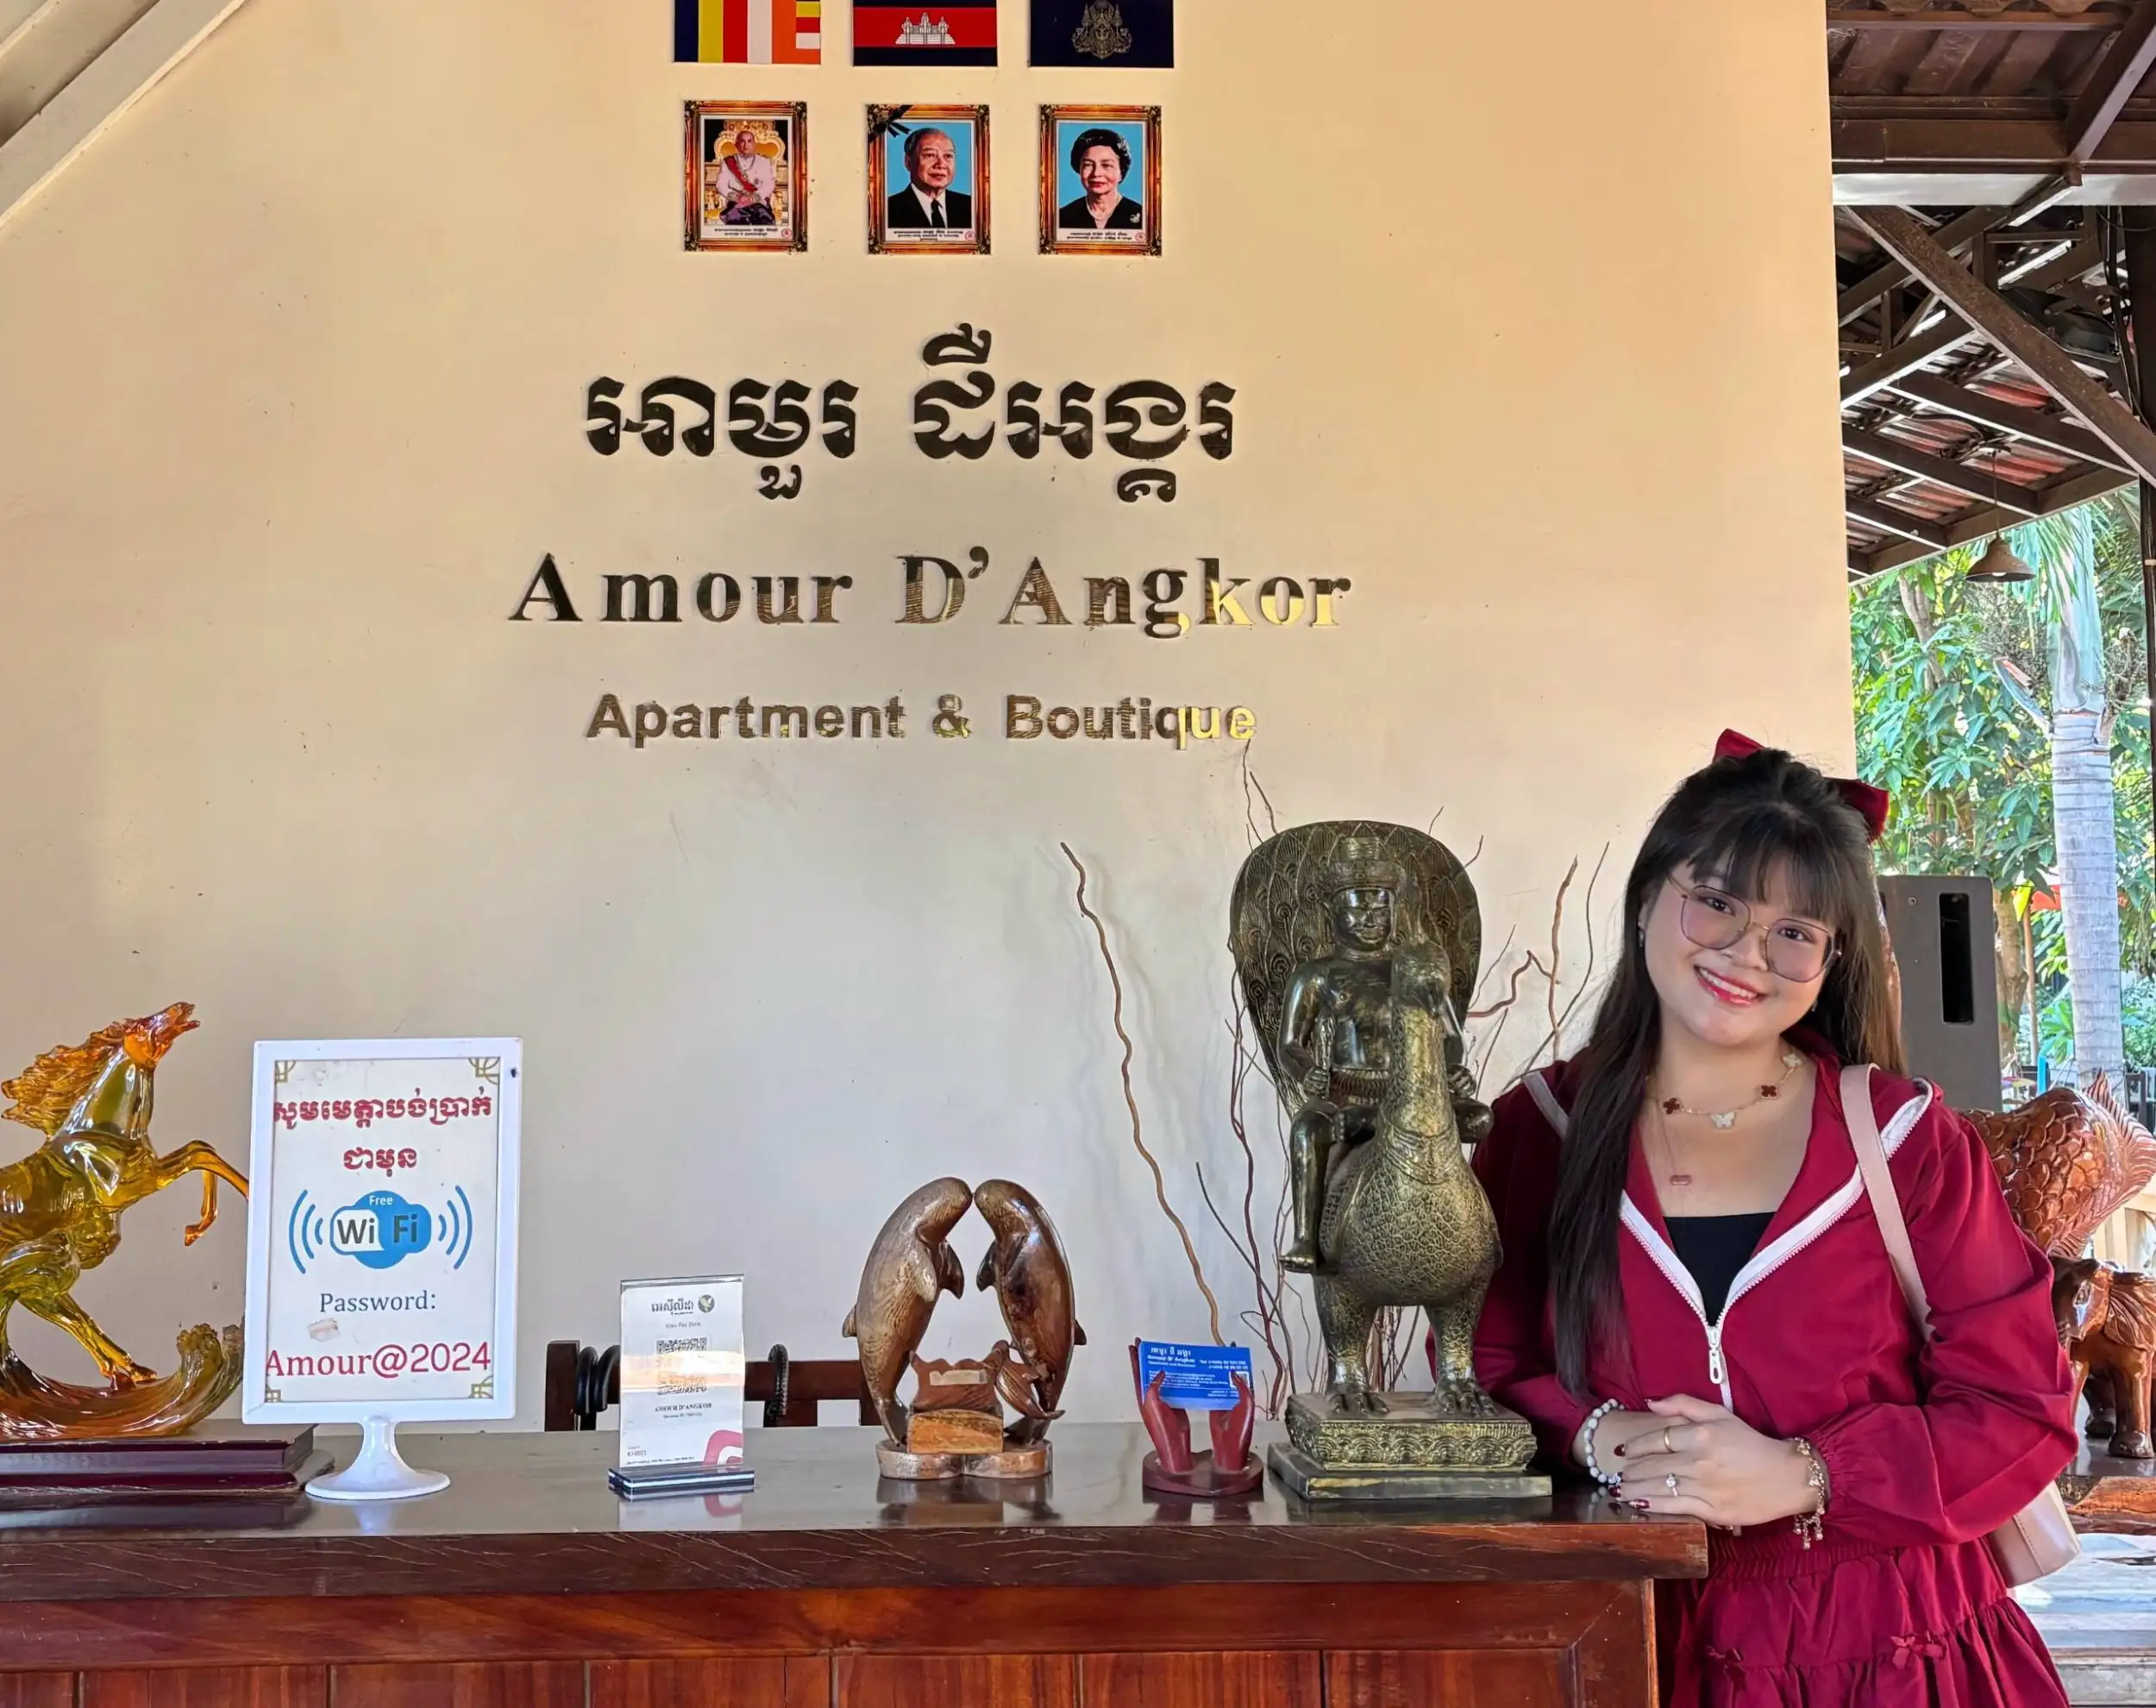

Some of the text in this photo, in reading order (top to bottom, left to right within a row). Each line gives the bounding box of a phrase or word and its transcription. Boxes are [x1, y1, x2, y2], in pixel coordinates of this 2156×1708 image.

[586, 376, 860, 501] អាមួរ
[507, 553, 854, 624] Amour
[586, 693, 1257, 750] Apartment & Boutique
[274, 1086, 492, 1129] សូមមេត្តាបង់ប្រាក់
[343, 1147, 417, 1177] ជាមុន
[369, 1194, 393, 1206] Free
[320, 1290, 436, 1313] Password:
[266, 1342, 492, 1380] Amour@2024
